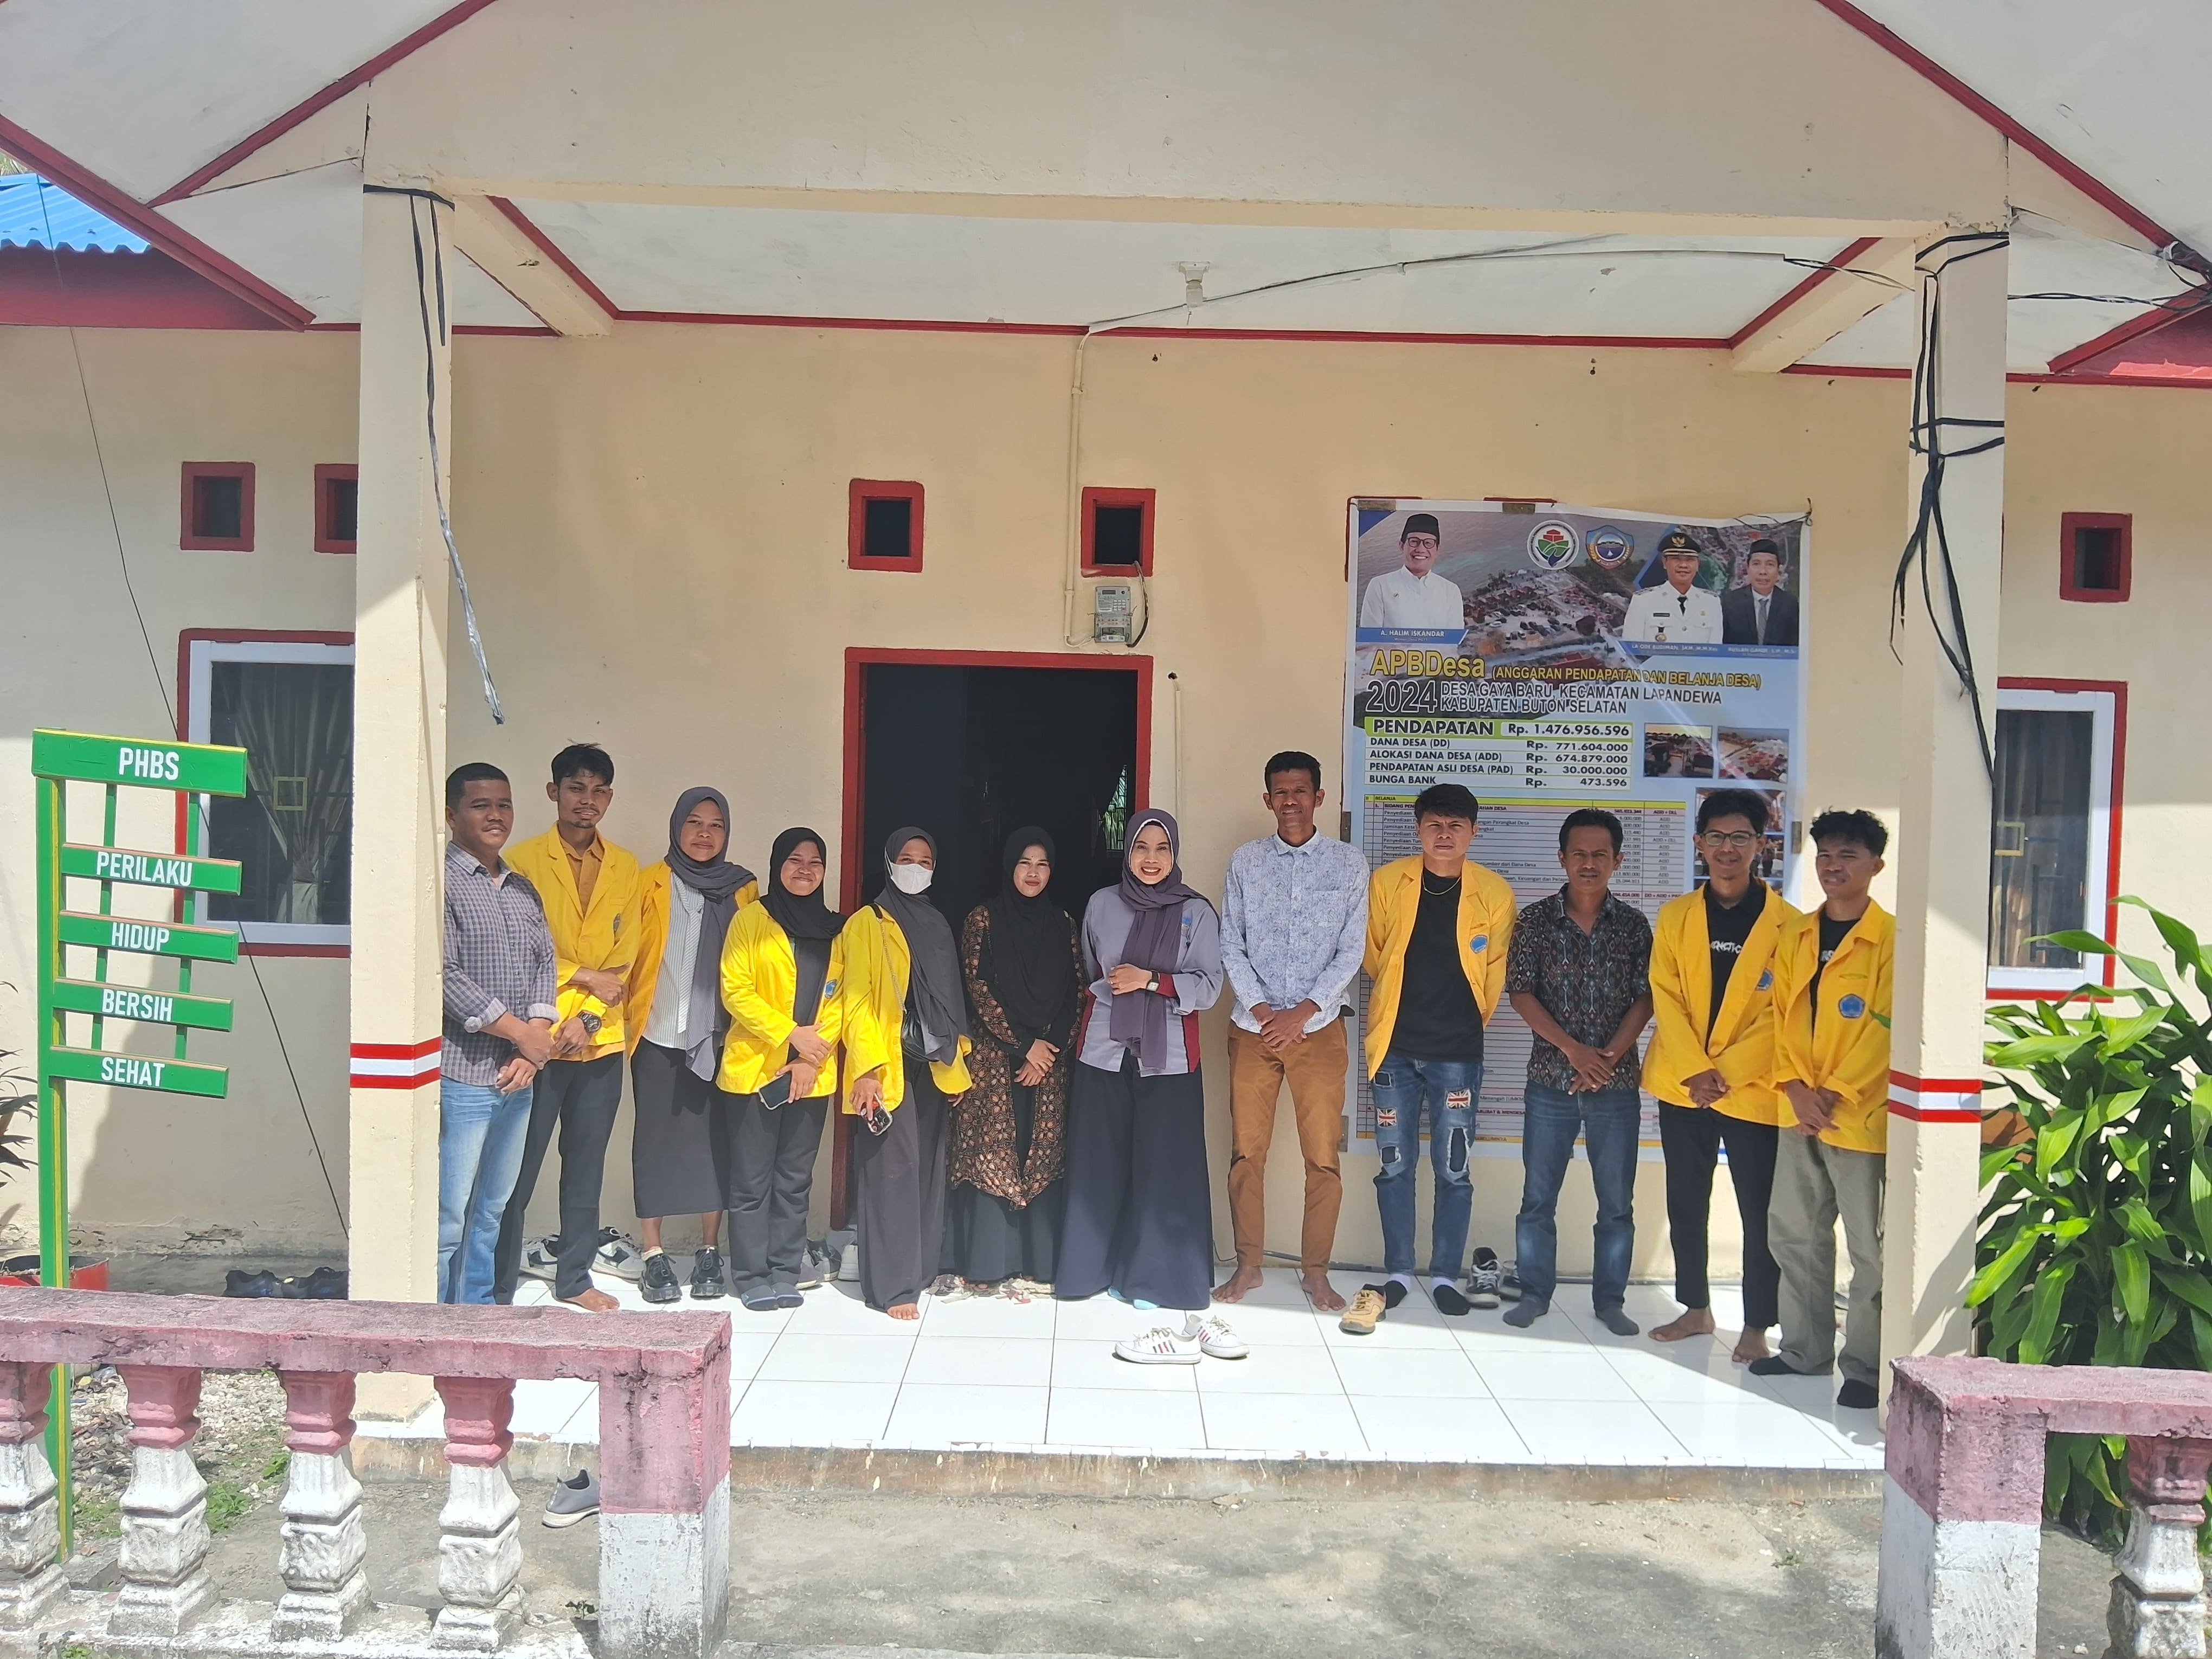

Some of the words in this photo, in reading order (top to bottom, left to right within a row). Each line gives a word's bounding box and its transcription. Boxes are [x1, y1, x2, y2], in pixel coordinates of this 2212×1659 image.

[1369, 649, 1486, 678] APBDesa
[1492, 666, 1562, 680] (ANGGARAN
[1565, 667, 1642, 682] PENDAPATAN
[1644, 670, 1667, 685] DAN
[1669, 671, 1725, 687] BELANJA
[1726, 673, 1762, 690] DESA)
[1365, 679, 1438, 713] 2024
[1441, 681, 1478, 697] DESA
[1479, 681, 1513, 698] GAYA
[1559, 684, 1639, 700] KECAMATAN
[1643, 689, 1722, 704] LAPANDEWA
[1440, 697, 1519, 713] KABUPATEN
[1521, 698, 1567, 714] BUTON
[1569, 699, 1627, 714] SELATAN
[1373, 718, 1494, 736] PENDAPATAN
[1508, 723, 1528, 736] Rp.
[1534, 724, 1630, 736] 1.476.956.596
[1370, 737, 1399, 747] DANA
[1402, 738, 1427, 747] DESA
[1430, 738, 1450, 749] (DD)
[1527, 740, 1548, 751] Rp.
[1555, 742, 1629, 752] 771.604.000
[119, 747, 179, 781] PHBS
[1369, 750, 1412, 759] ALOKASI
[1415, 750, 1445, 760] DANA
[1447, 751, 1472, 761] DESA
[1475, 751, 1502, 762] (ADD)
[1526, 753, 1547, 763] Rp.
[1555, 754, 1628, 764] 674.879.000
[1369, 762, 1434, 772] PENDAPATAN
[1437, 763, 1457, 773] ASLI
[1460, 764, 1484, 773] DESA
[1487, 764, 1514, 775] (PAD)
[1526, 765, 1547, 776] Rp.
[1562, 766, 1628, 775] 30.000.000
[1369, 775, 1405, 784] BUNGA
[1408, 775, 1437, 785] BANK
[1525, 777, 1547, 788] Rp.
[1579, 778, 1627, 787] 473.596
[96, 851, 193, 888] PERILAKU
[111, 922, 170, 952] HIDUP
[102, 988, 173, 1023] BERSIH
[101, 1057, 165, 1088] SEHAT
